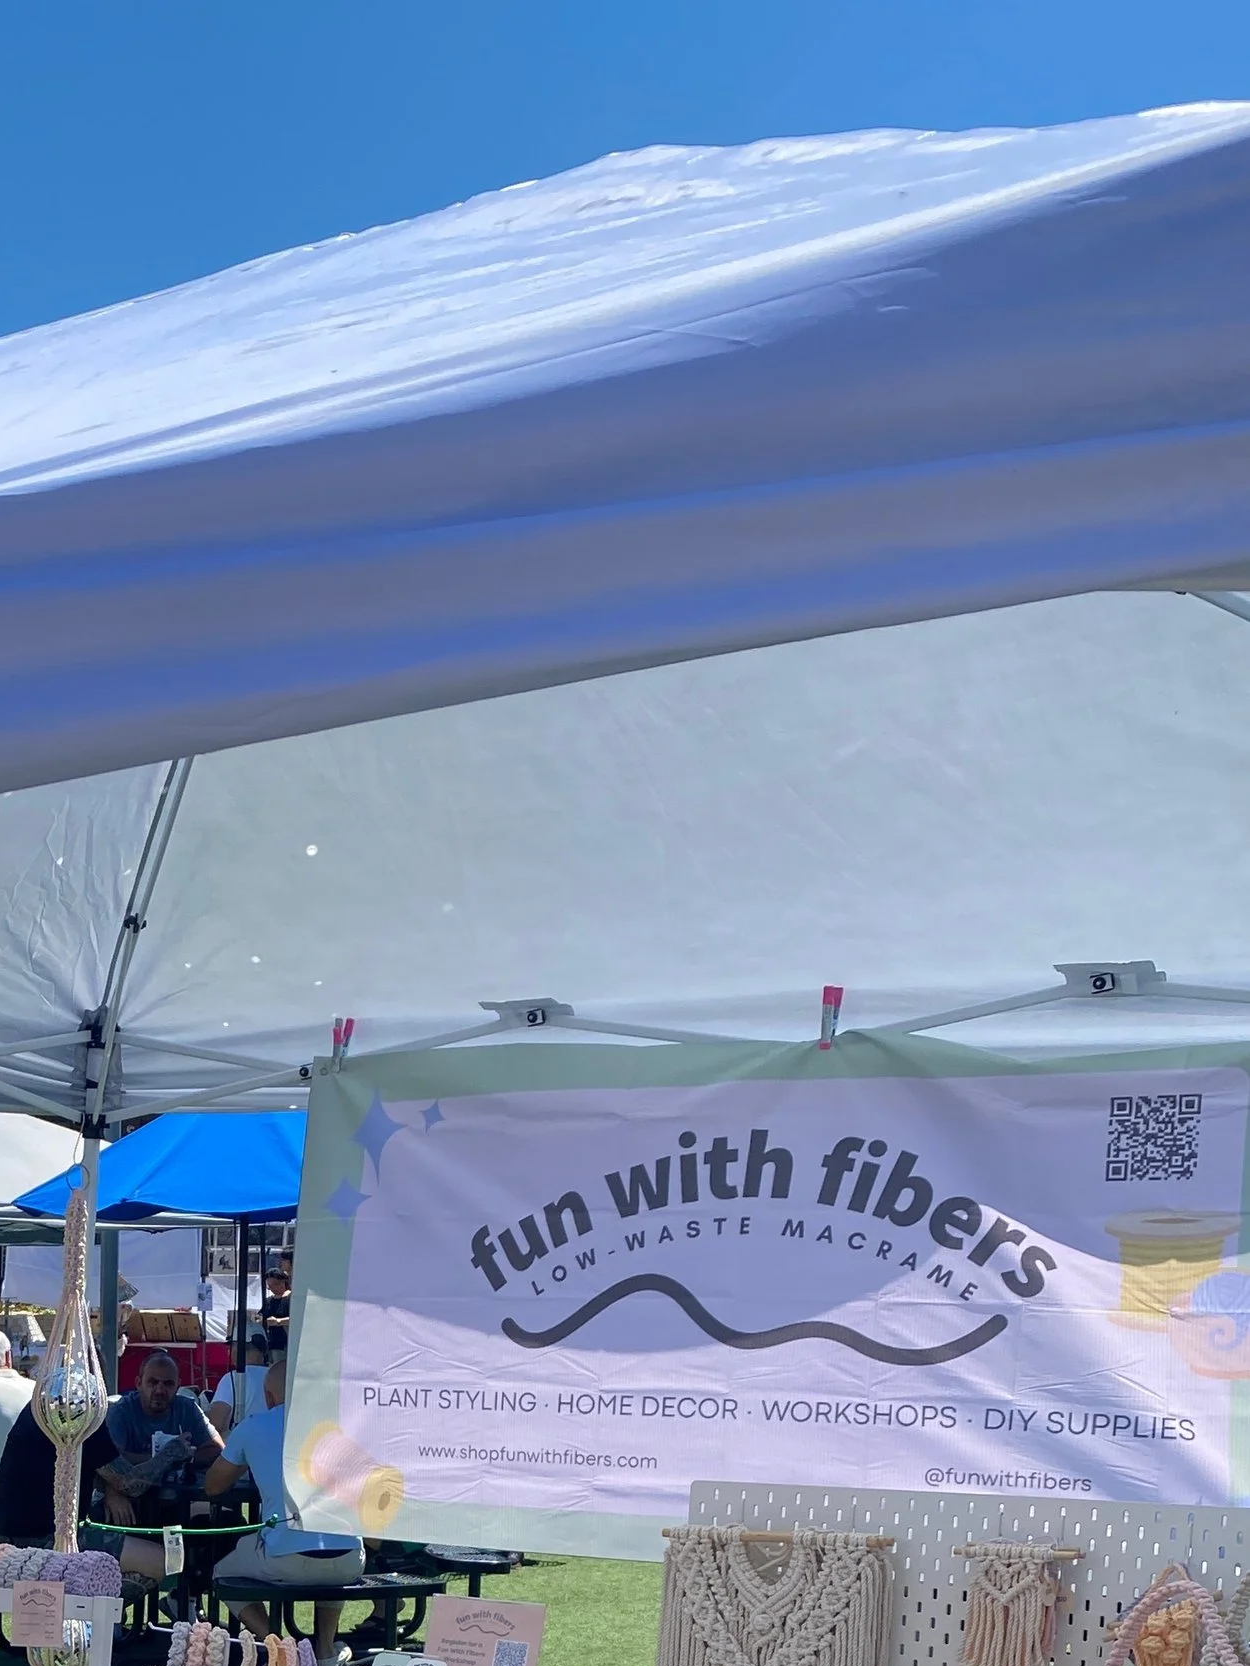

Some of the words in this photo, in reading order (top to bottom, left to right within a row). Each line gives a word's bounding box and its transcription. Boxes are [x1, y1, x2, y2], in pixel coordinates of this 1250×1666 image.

[470, 1190, 593, 1292] fun
[604, 1128, 793, 1218] with
[816, 1136, 1057, 1298] fibers
[531, 1216, 751, 1296] LOW-WASTE
[780, 1218, 979, 1301] MACRAME
[363, 1387, 432, 1409] PLANT
[438, 1389, 537, 1413] STYLING
[557, 1393, 634, 1416] HOME
[641, 1396, 739, 1420] DECOR
[761, 1399, 958, 1429] WORKSHOPS
[984, 1408, 1038, 1432] DIY
[1046, 1411, 1196, 1441] SUPPLIES
[418, 1445, 658, 1470] www.shopfunwithfibers.com
[924, 1467, 1093, 1492] @funwithfibers
[472, 1609, 492, 1619] with
